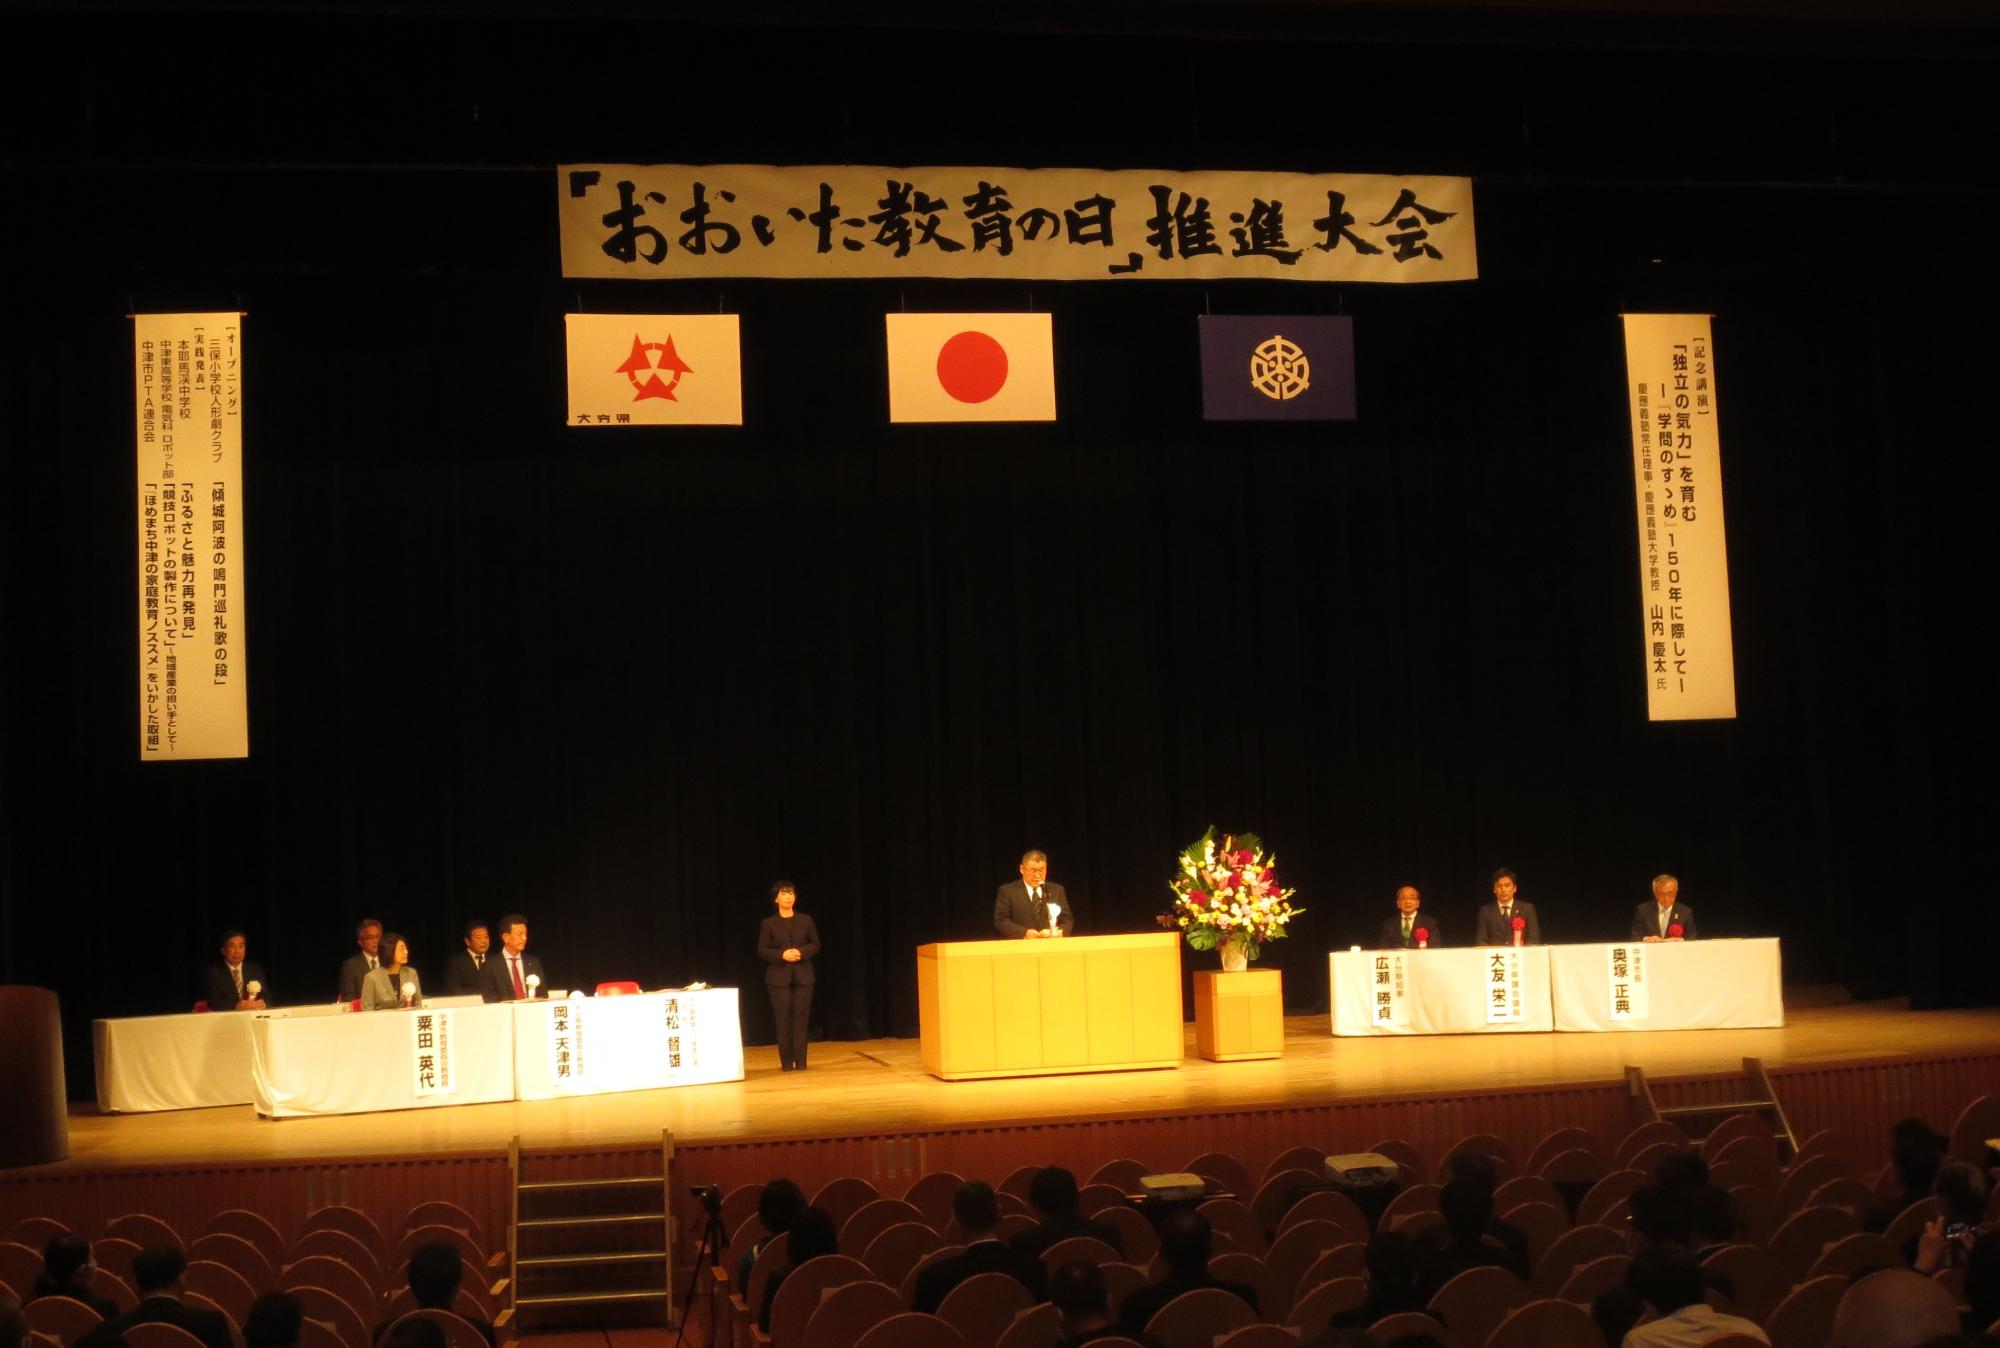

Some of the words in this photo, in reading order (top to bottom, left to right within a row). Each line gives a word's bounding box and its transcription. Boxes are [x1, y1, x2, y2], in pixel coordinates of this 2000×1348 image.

[570, 170, 1457, 276] 「おおいた教育の日」推進大会
